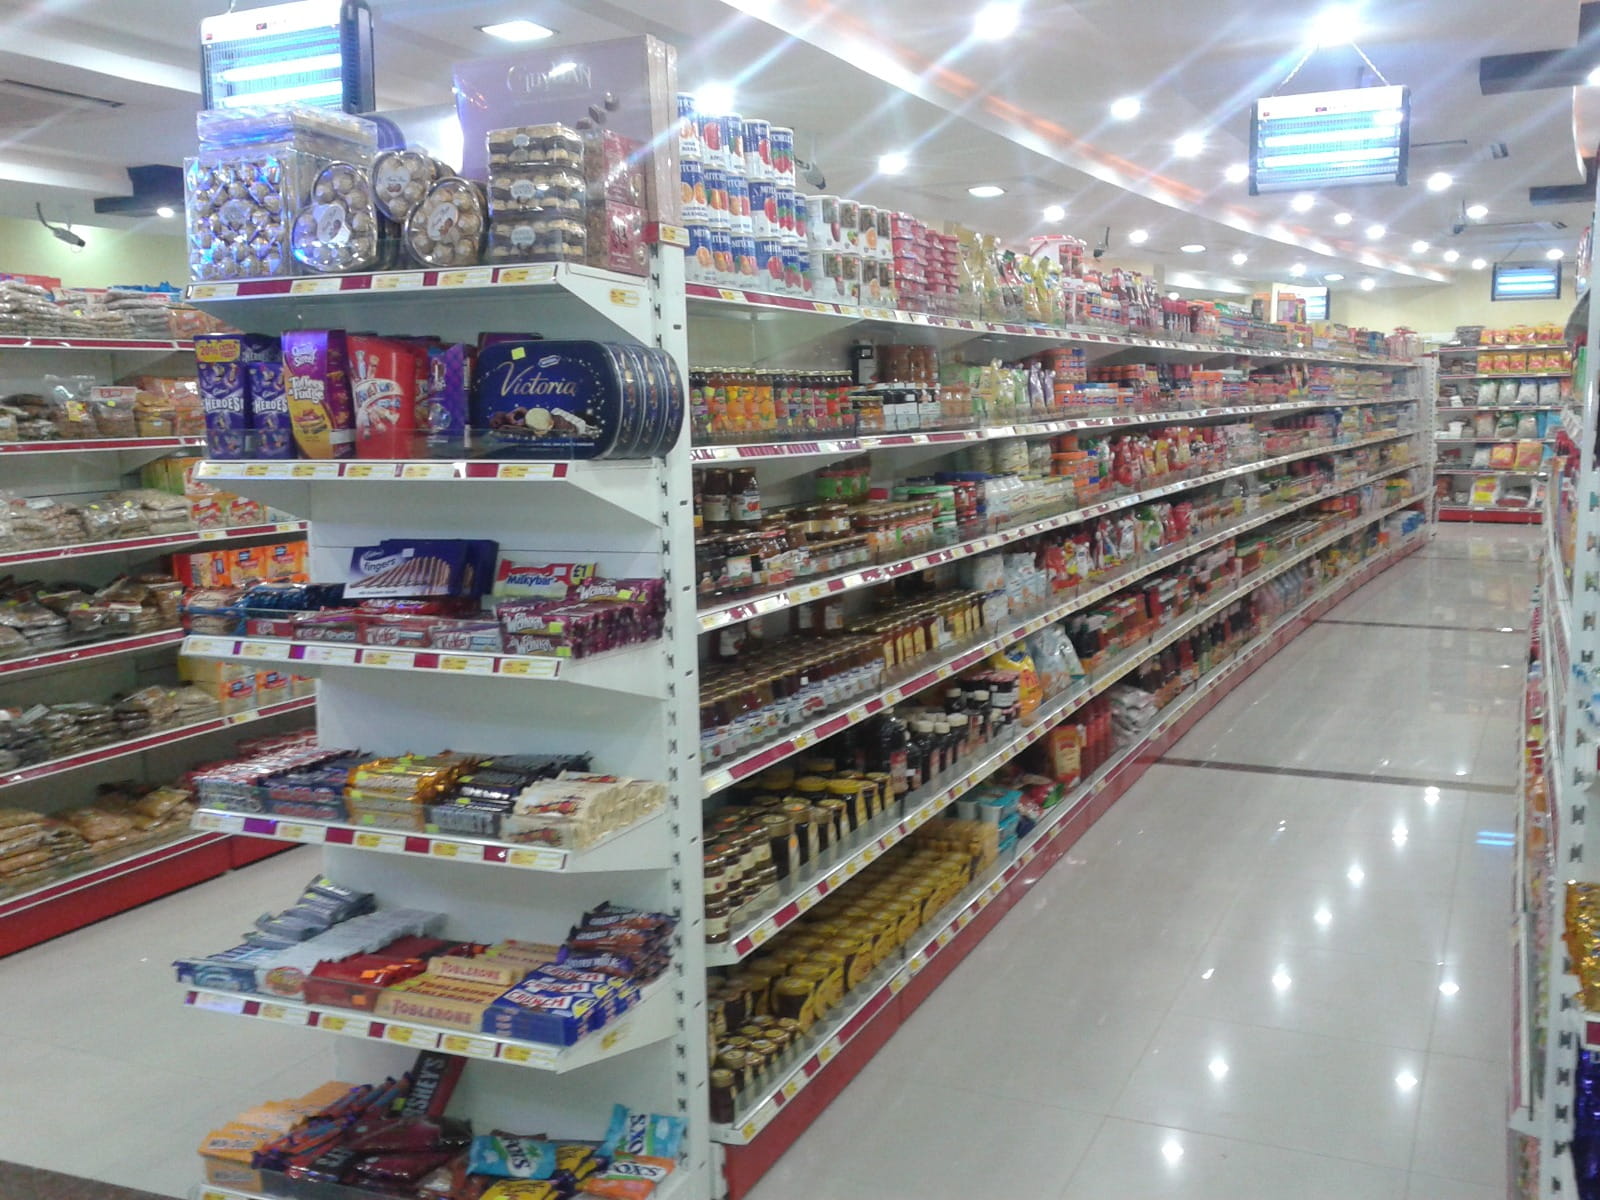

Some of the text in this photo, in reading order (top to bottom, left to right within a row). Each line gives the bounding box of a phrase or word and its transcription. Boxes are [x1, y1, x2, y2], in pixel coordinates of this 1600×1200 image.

[498, 361, 577, 397] Victoria
[294, 388, 325, 404] Fudge
[253, 399, 288, 414] HEROES
[364, 559, 396, 573] fingers
[573, 564, 587, 578] £1
[506, 574, 554, 586] Milkybar
[543, 965, 599, 982] CRUNCH
[508, 990, 566, 1008] CRUNCH
[393, 999, 472, 1025] TOBLERONE
